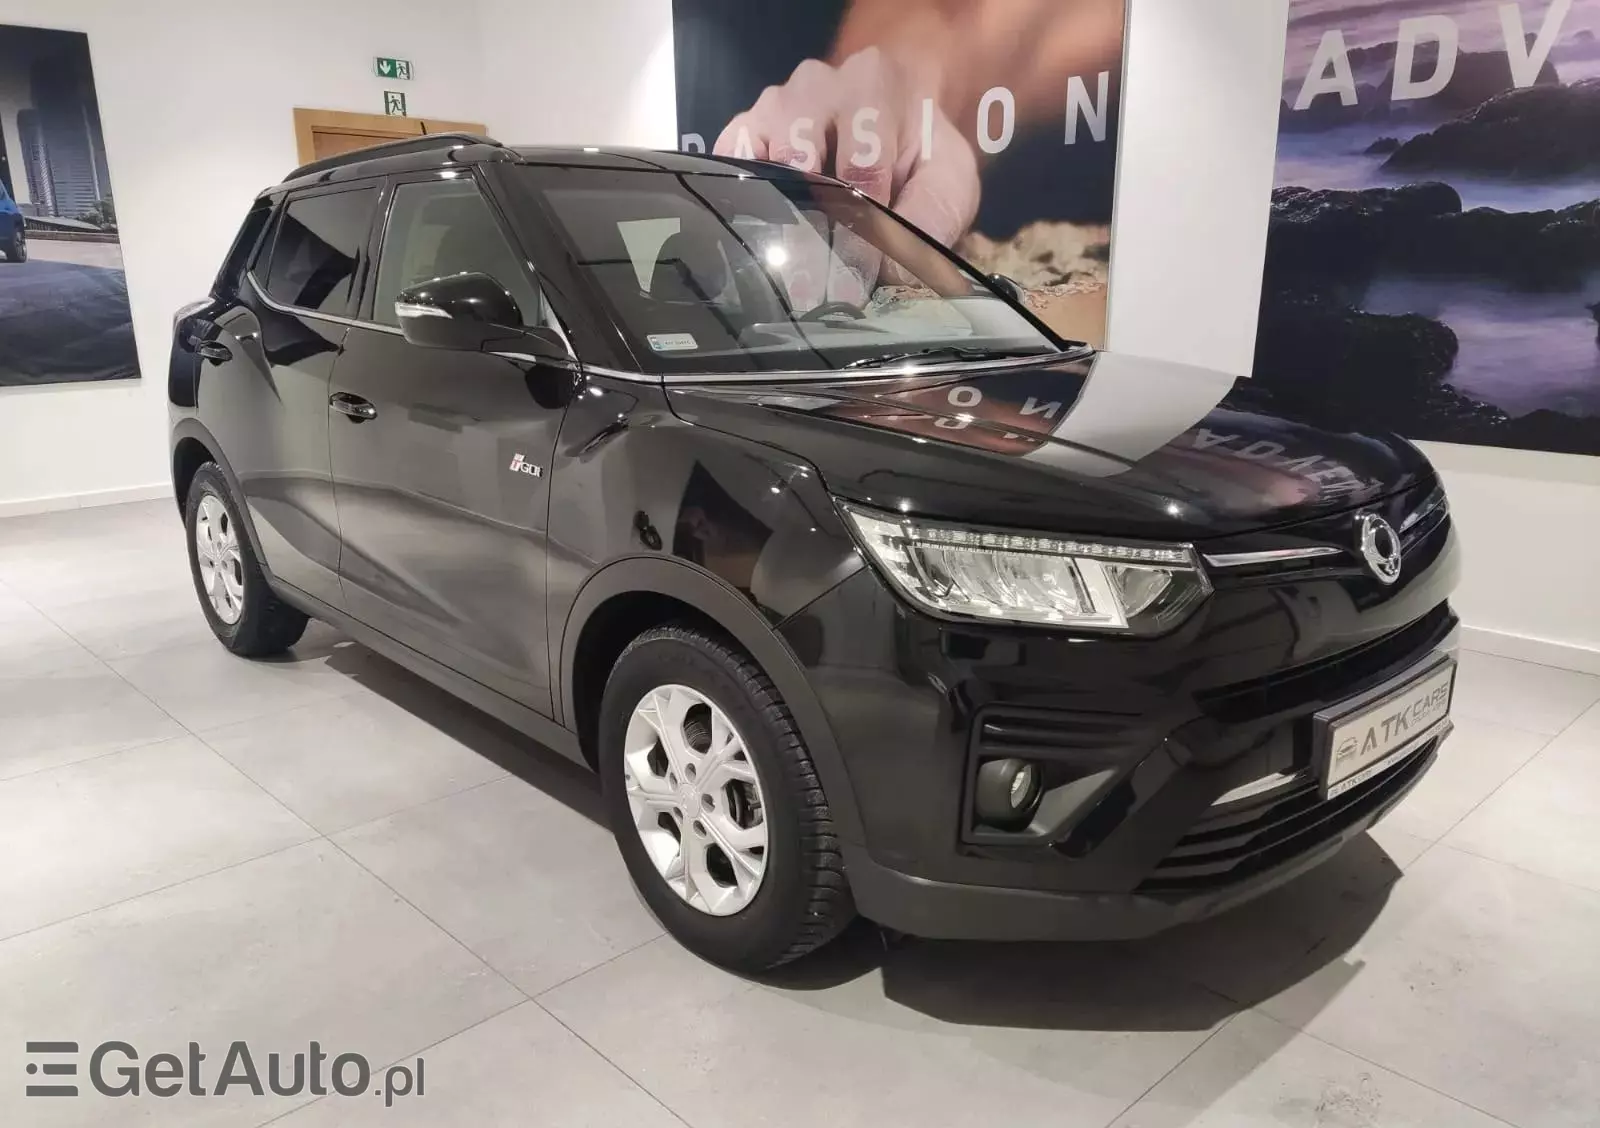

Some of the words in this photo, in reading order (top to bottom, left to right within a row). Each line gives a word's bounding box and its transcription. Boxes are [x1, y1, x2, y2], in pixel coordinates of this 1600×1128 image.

[1293, 0, 1567, 110] ADV
[1360, 704, 1413, 756] ATK
[1412, 681, 1449, 717] CARS
